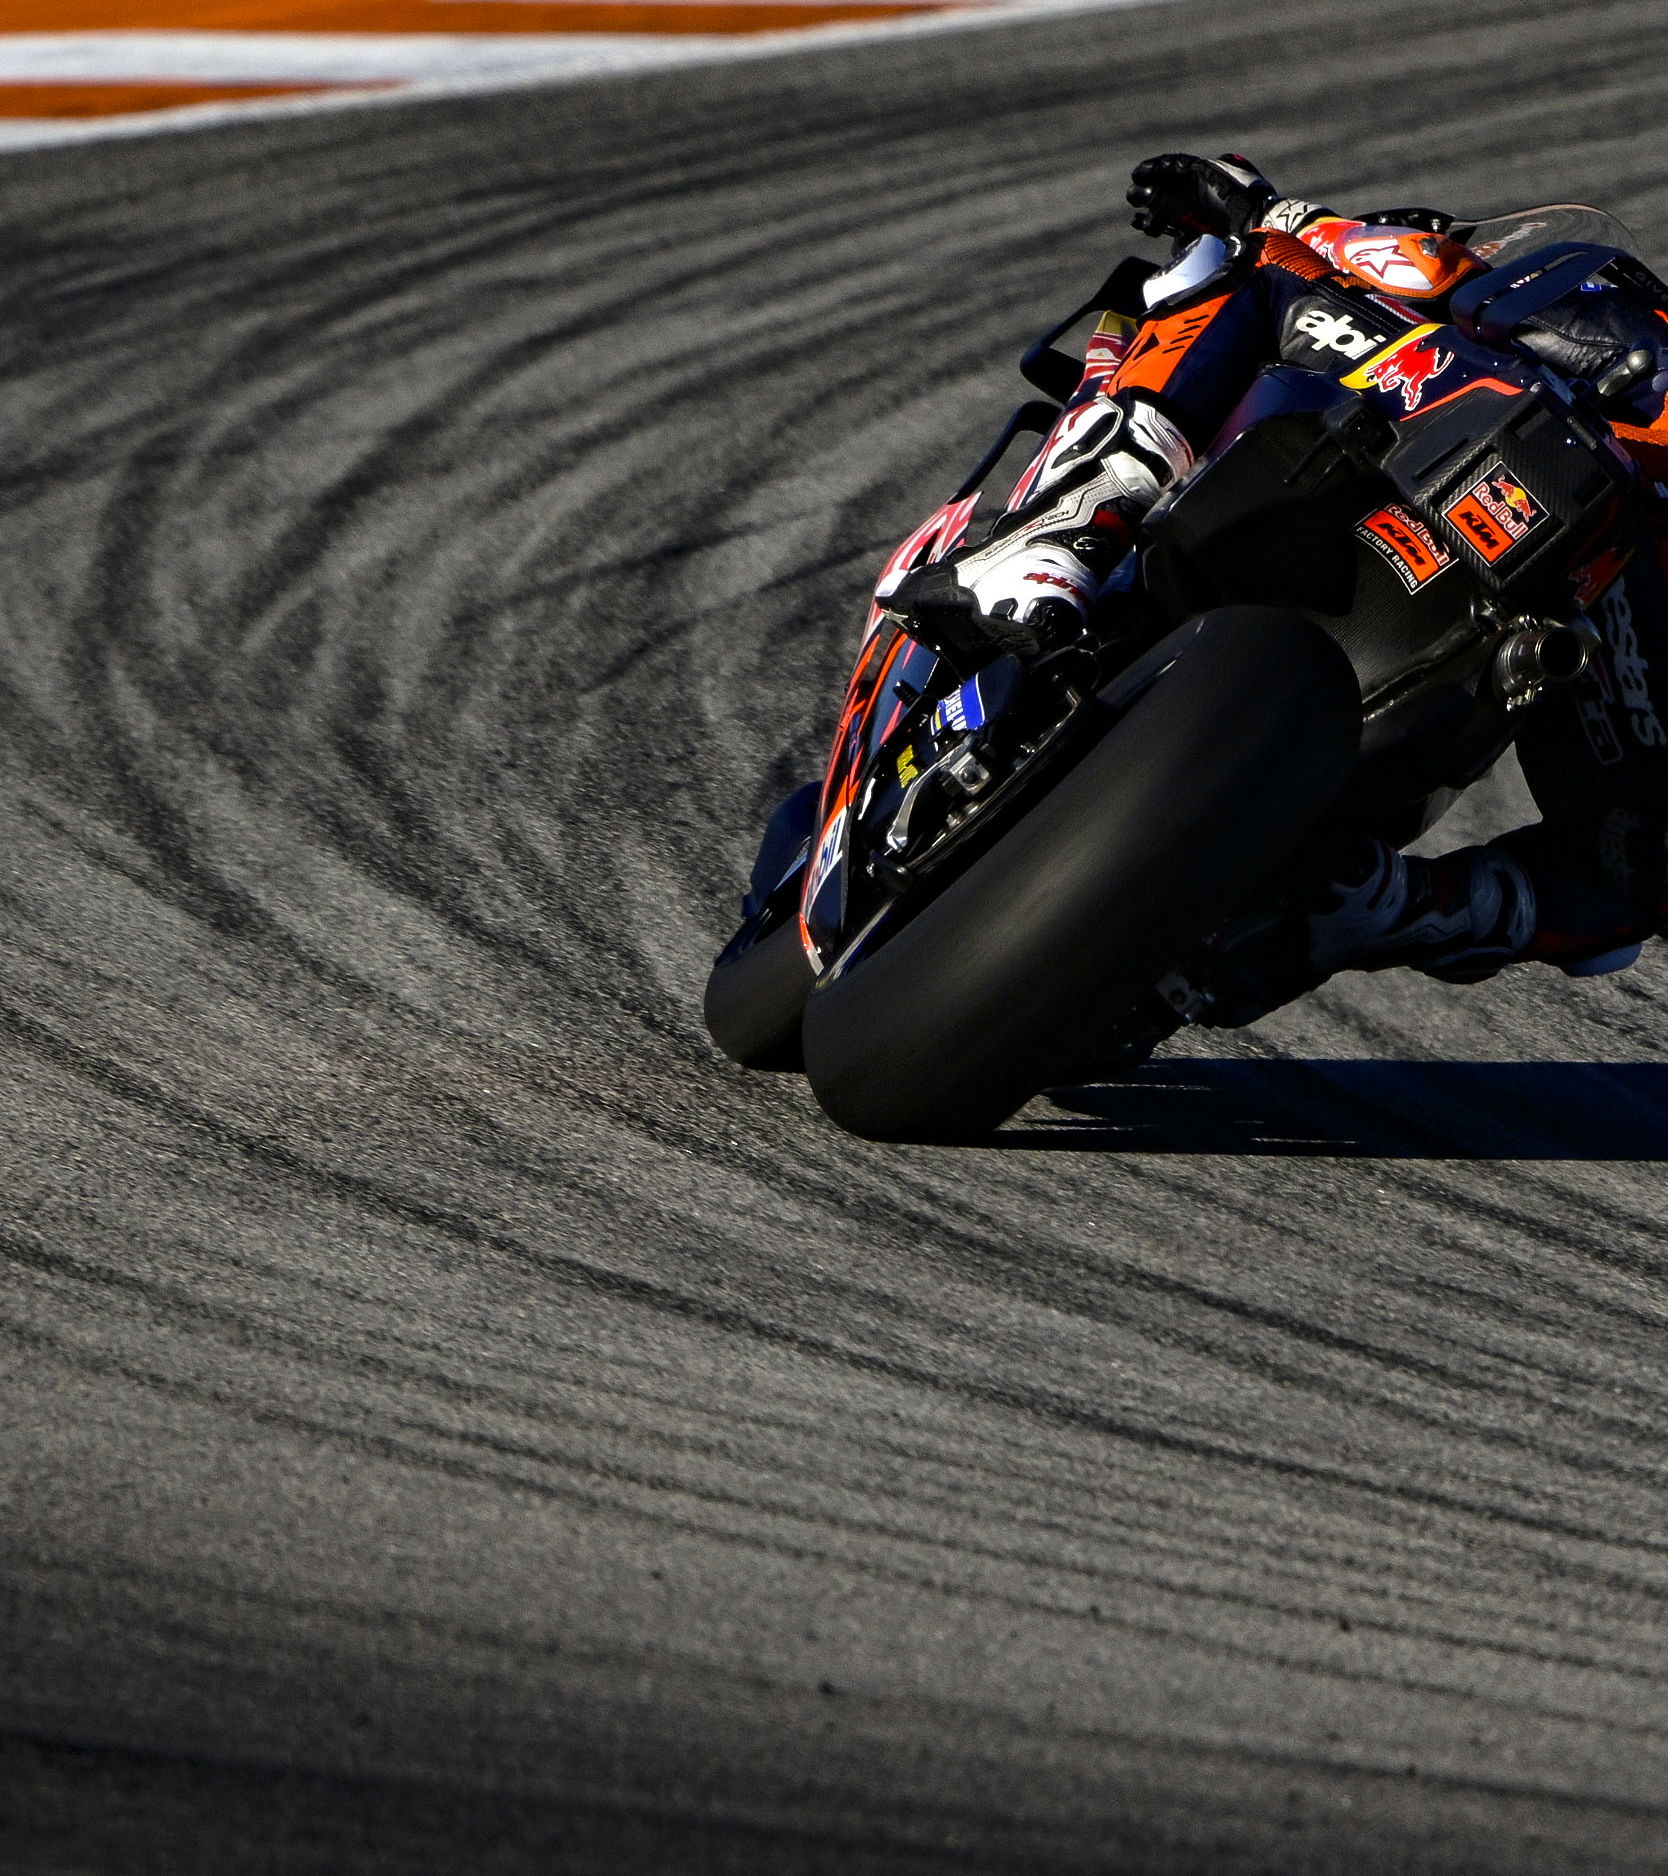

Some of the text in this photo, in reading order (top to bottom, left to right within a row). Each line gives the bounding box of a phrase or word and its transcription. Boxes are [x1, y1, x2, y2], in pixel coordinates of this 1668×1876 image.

[1378, 522, 1426, 566] KTM
[1458, 511, 1500, 550] KTM
[1356, 526, 1419, 590] FACTORY RACING
